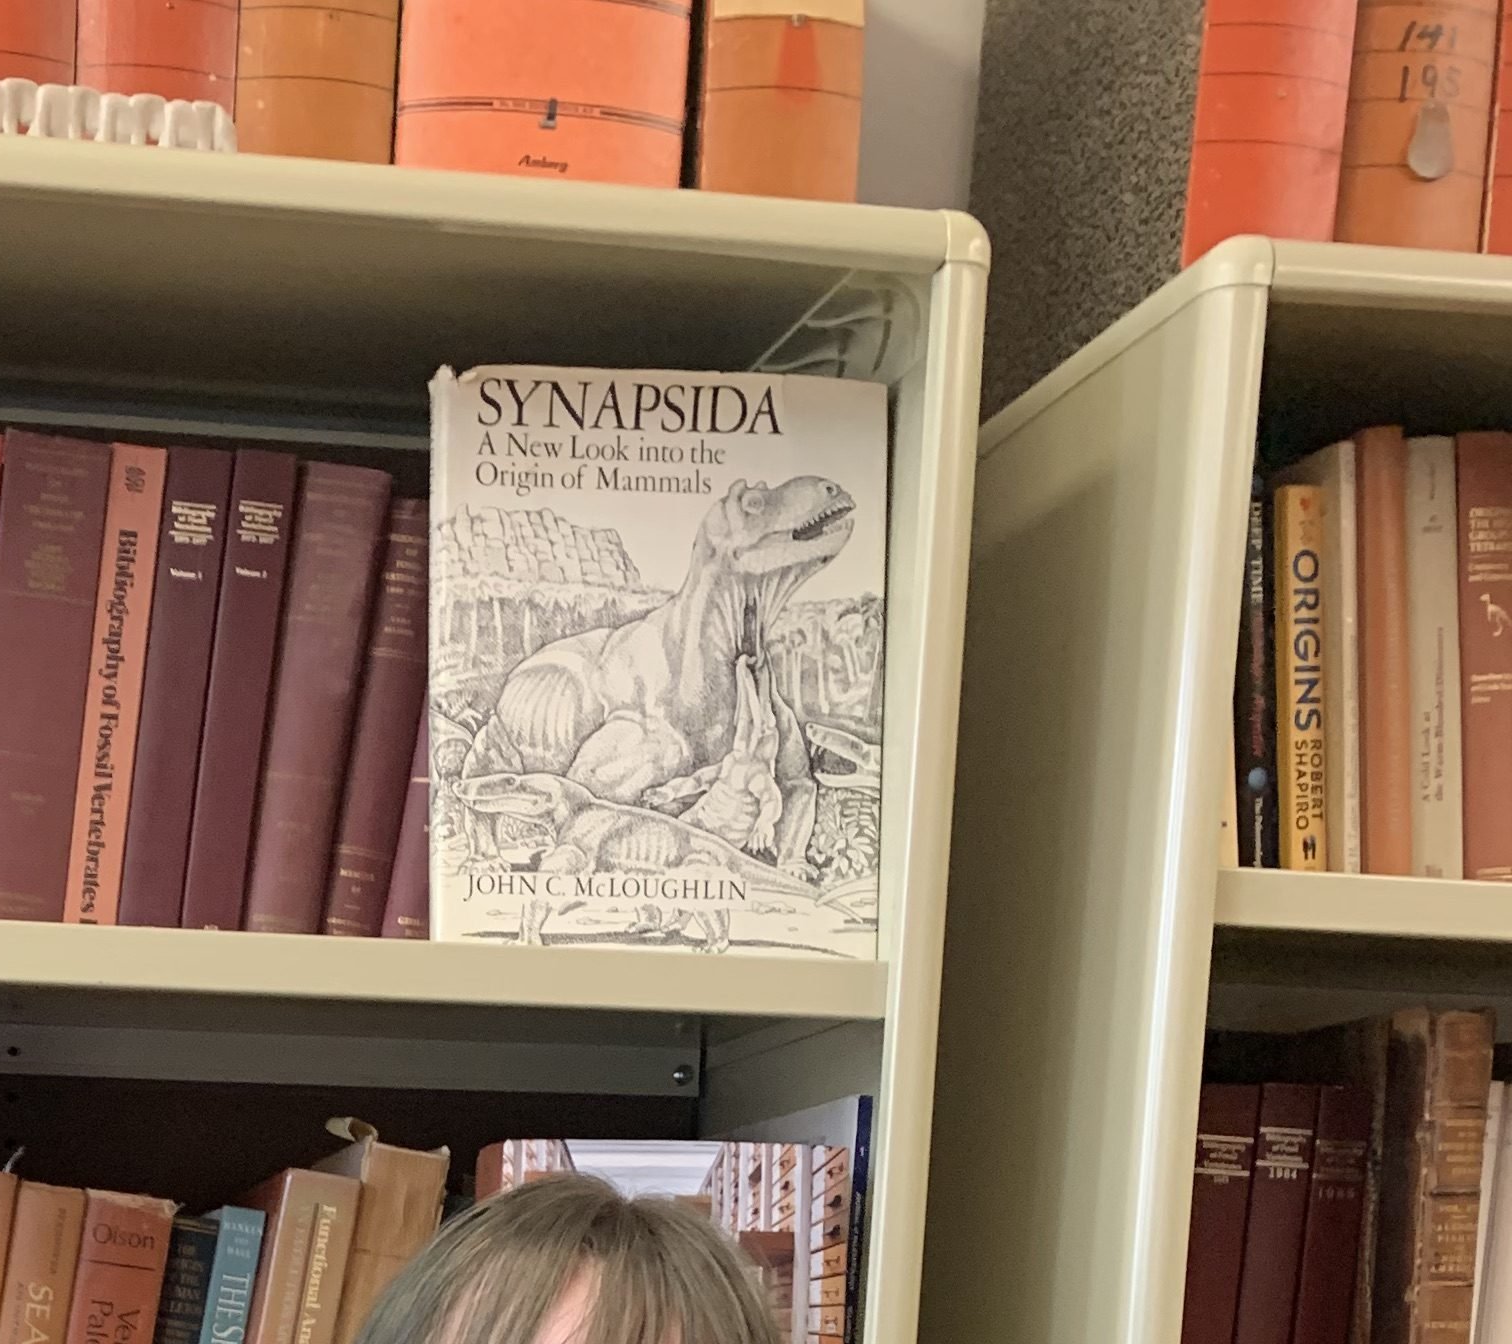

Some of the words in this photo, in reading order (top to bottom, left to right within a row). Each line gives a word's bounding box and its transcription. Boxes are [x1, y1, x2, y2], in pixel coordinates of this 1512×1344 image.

[477, 376, 785, 436] SYNAPSIDA
[475, 461, 555, 497] Origin
[560, 464, 588, 489] of
[595, 466, 713, 494] Mammals
[477, 431, 497, 456] A
[506, 432, 564, 459] New
[569, 434, 630, 462] Look
[638, 436, 685, 463] into
[690, 439, 727, 465] the
[98, 529, 138, 680] Bibliography
[1292, 548, 1323, 732] ORIGINS
[95, 711, 120, 778] Fossil
[1294, 739, 1311, 831] SHAPIRO
[1309, 738, 1324, 820] ROBERT
[79, 782, 114, 914] Vertebrates
[463, 874, 538, 902] JOHN
[545, 875, 566, 897] C.
[574, 876, 748, 901] McLOUGHLIN
[91, 1223, 156, 1251] Olson
[305, 1203, 338, 1310] Functional
[214, 1272, 251, 1321] THE
